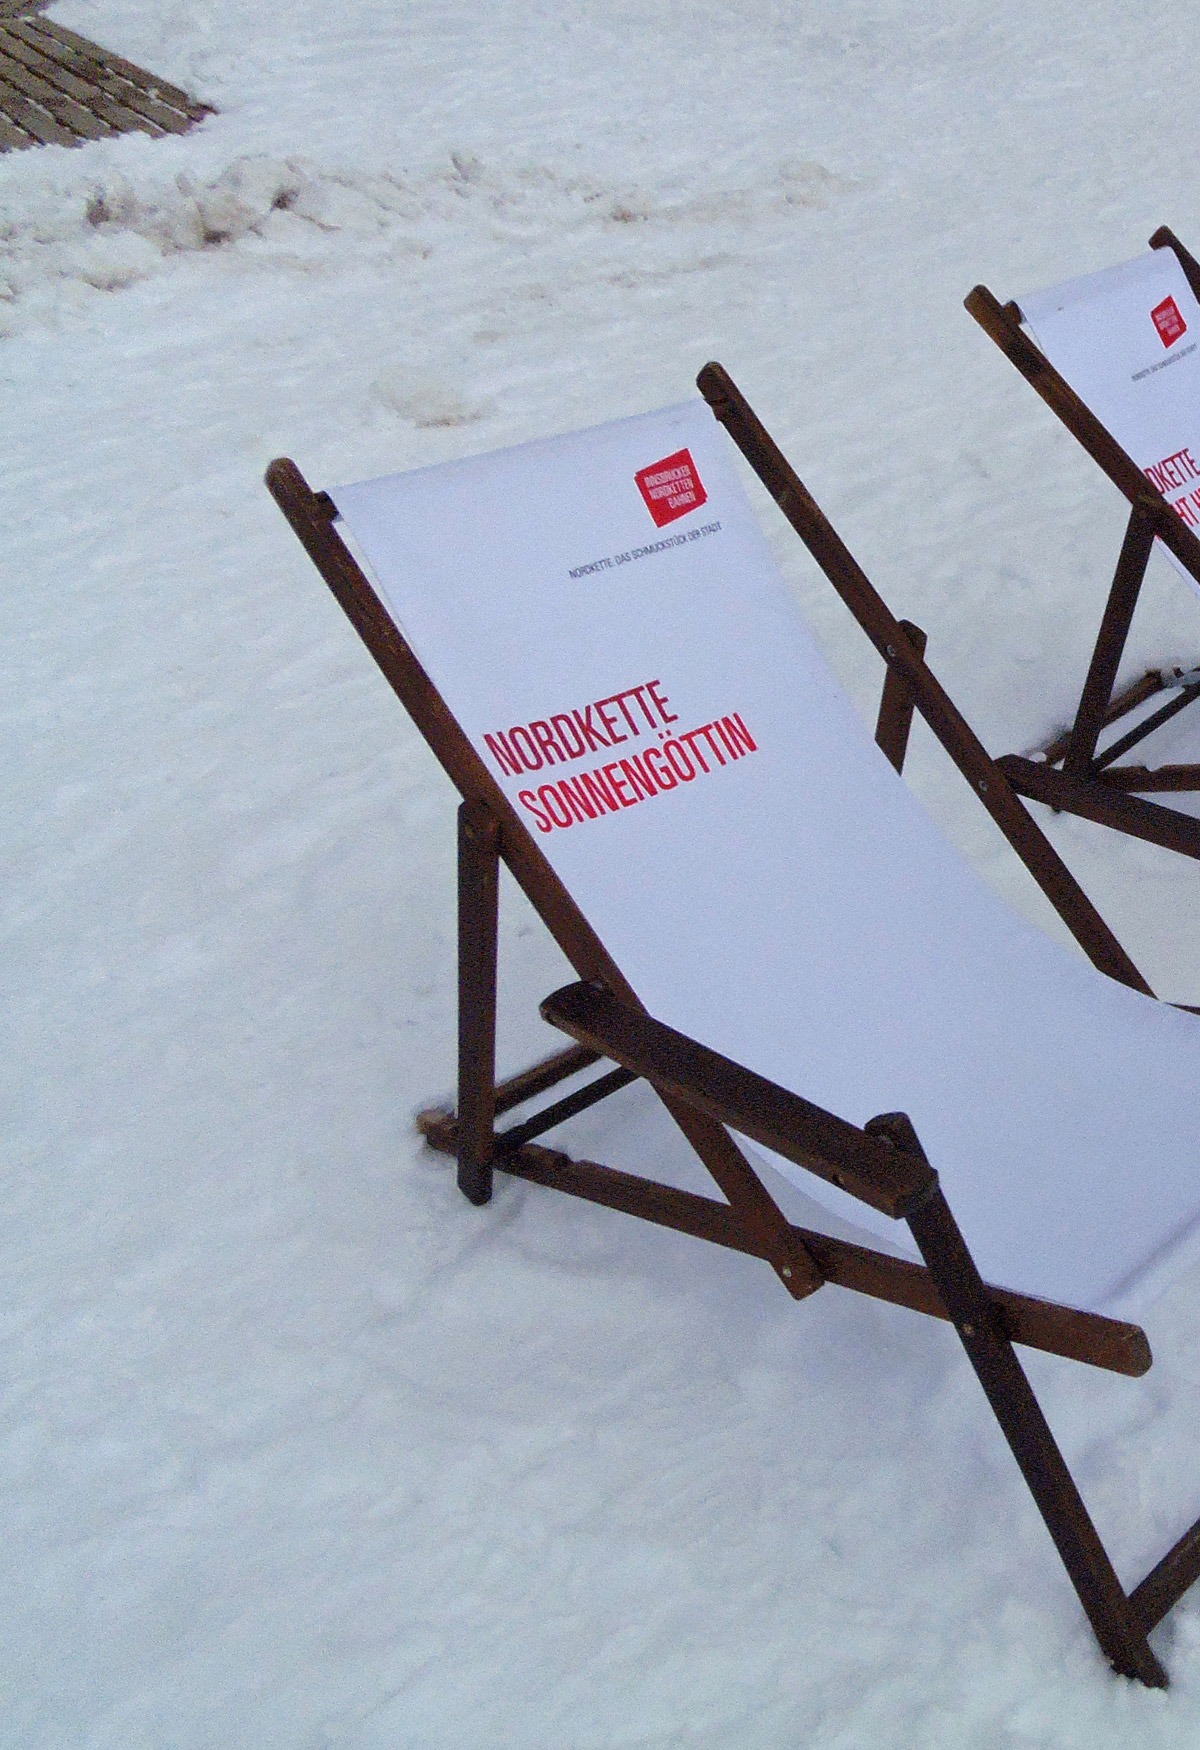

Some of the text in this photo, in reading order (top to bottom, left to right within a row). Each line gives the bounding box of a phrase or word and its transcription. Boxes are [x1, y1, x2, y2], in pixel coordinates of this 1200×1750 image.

[615, 552, 632, 566] DAS
[631, 534, 688, 560] SCHMUCKSTÜCK
[687, 529, 702, 542] DER
[700, 521, 722, 537] STADT
[483, 679, 679, 777] NORDKETTE
[518, 711, 758, 833] SONNENGÖTTIN
